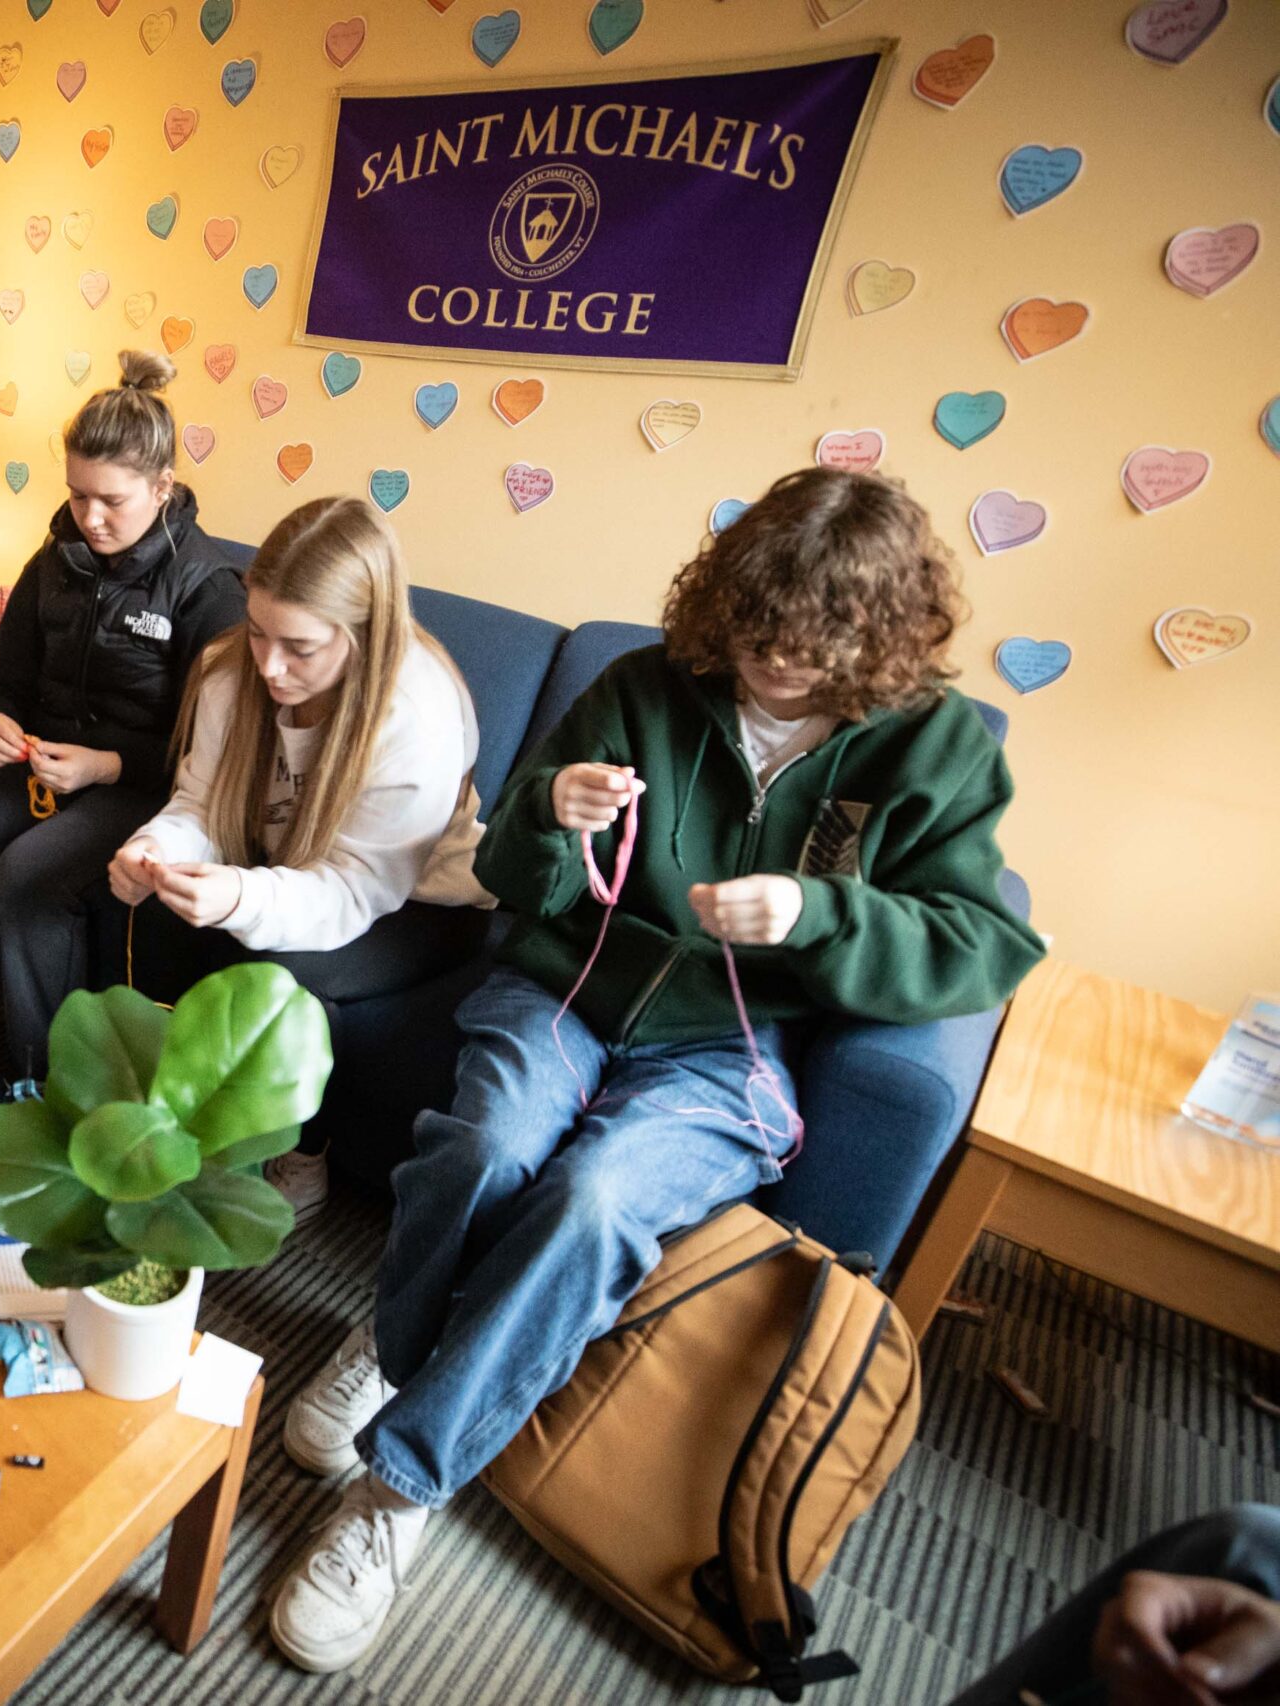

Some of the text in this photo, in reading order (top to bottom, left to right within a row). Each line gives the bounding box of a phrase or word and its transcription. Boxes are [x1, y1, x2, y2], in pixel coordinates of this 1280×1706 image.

[356, 103, 805, 199] SAINT MICHAEL'S
[502, 182, 526, 209] SAINT
[407, 284, 656, 336] COLLEGE
[124, 614, 158, 629] NORTH
[141, 610, 159, 621] THE
